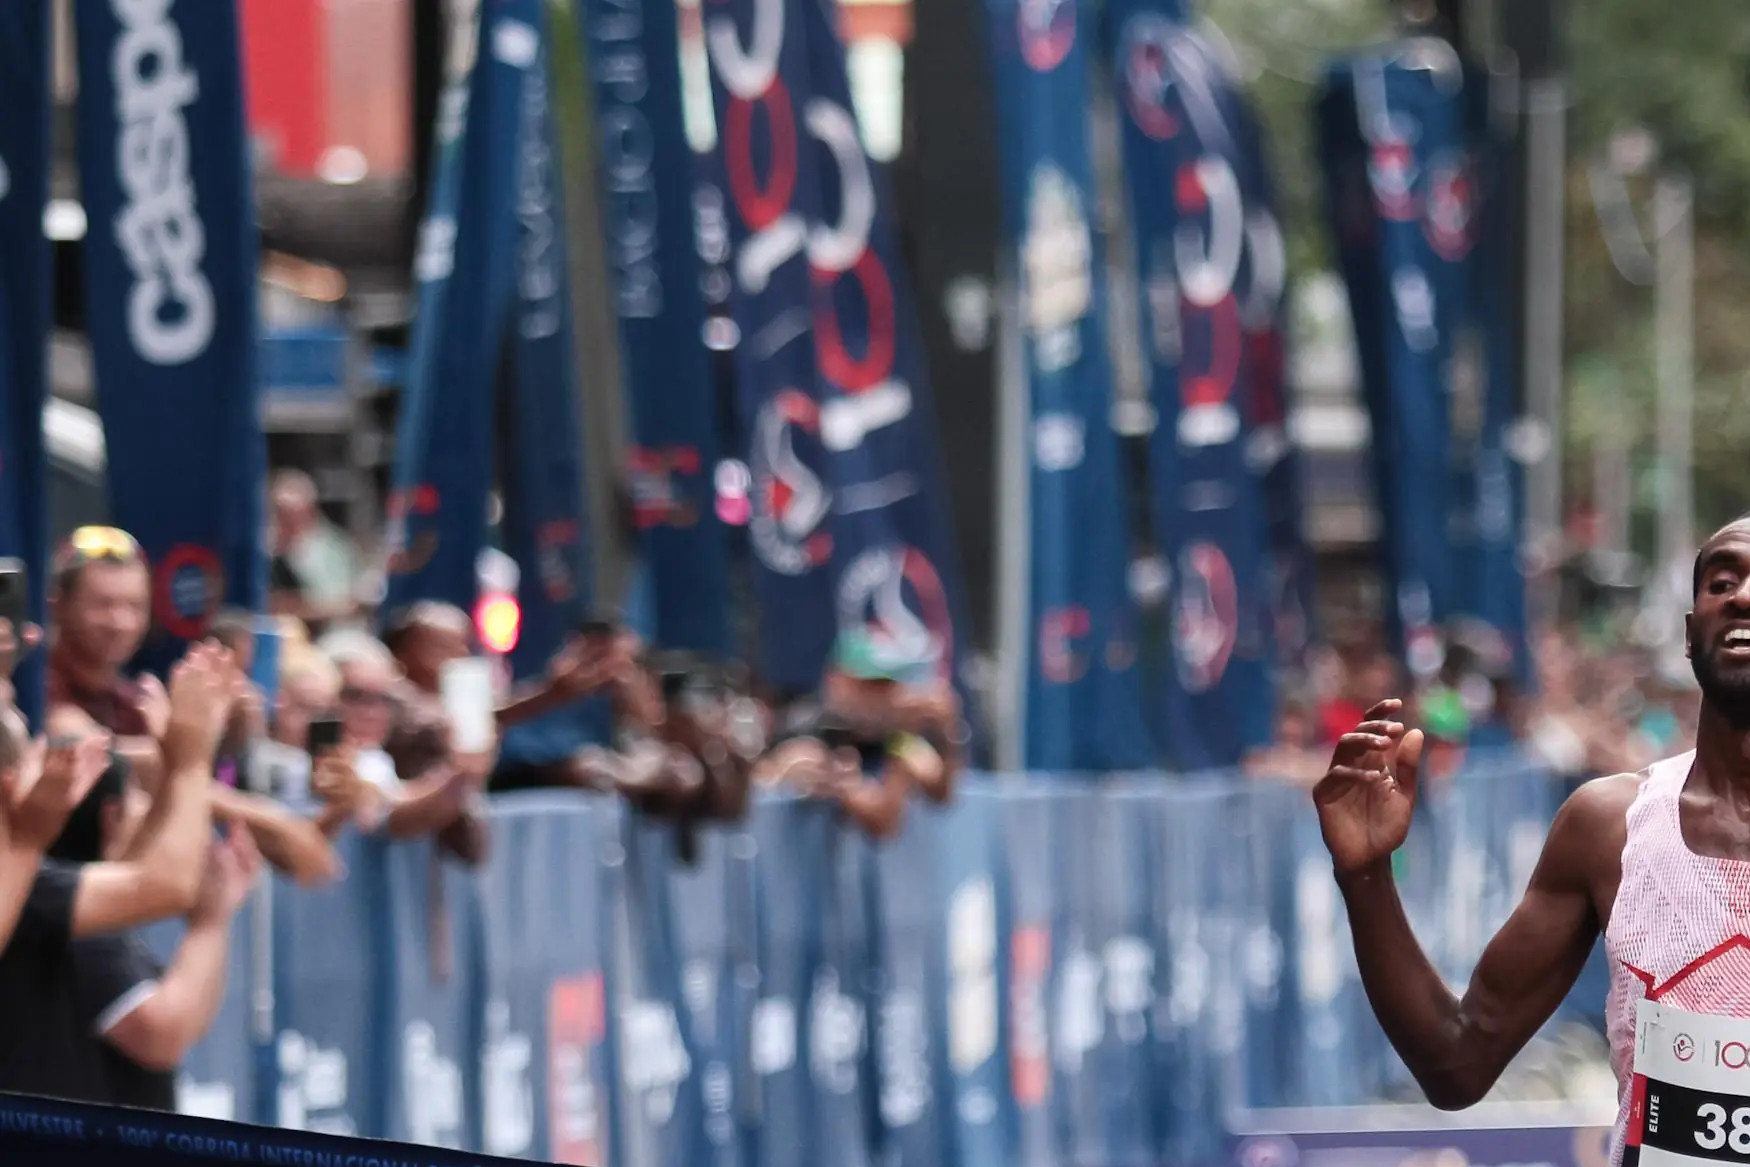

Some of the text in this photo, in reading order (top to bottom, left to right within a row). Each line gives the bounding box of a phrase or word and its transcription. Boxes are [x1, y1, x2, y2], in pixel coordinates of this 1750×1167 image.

[0, 1108, 85, 1140] ILVESTRE
[165, 1133, 250, 1161] CORRIDA
[1648, 1095, 1661, 1133] ELITE
